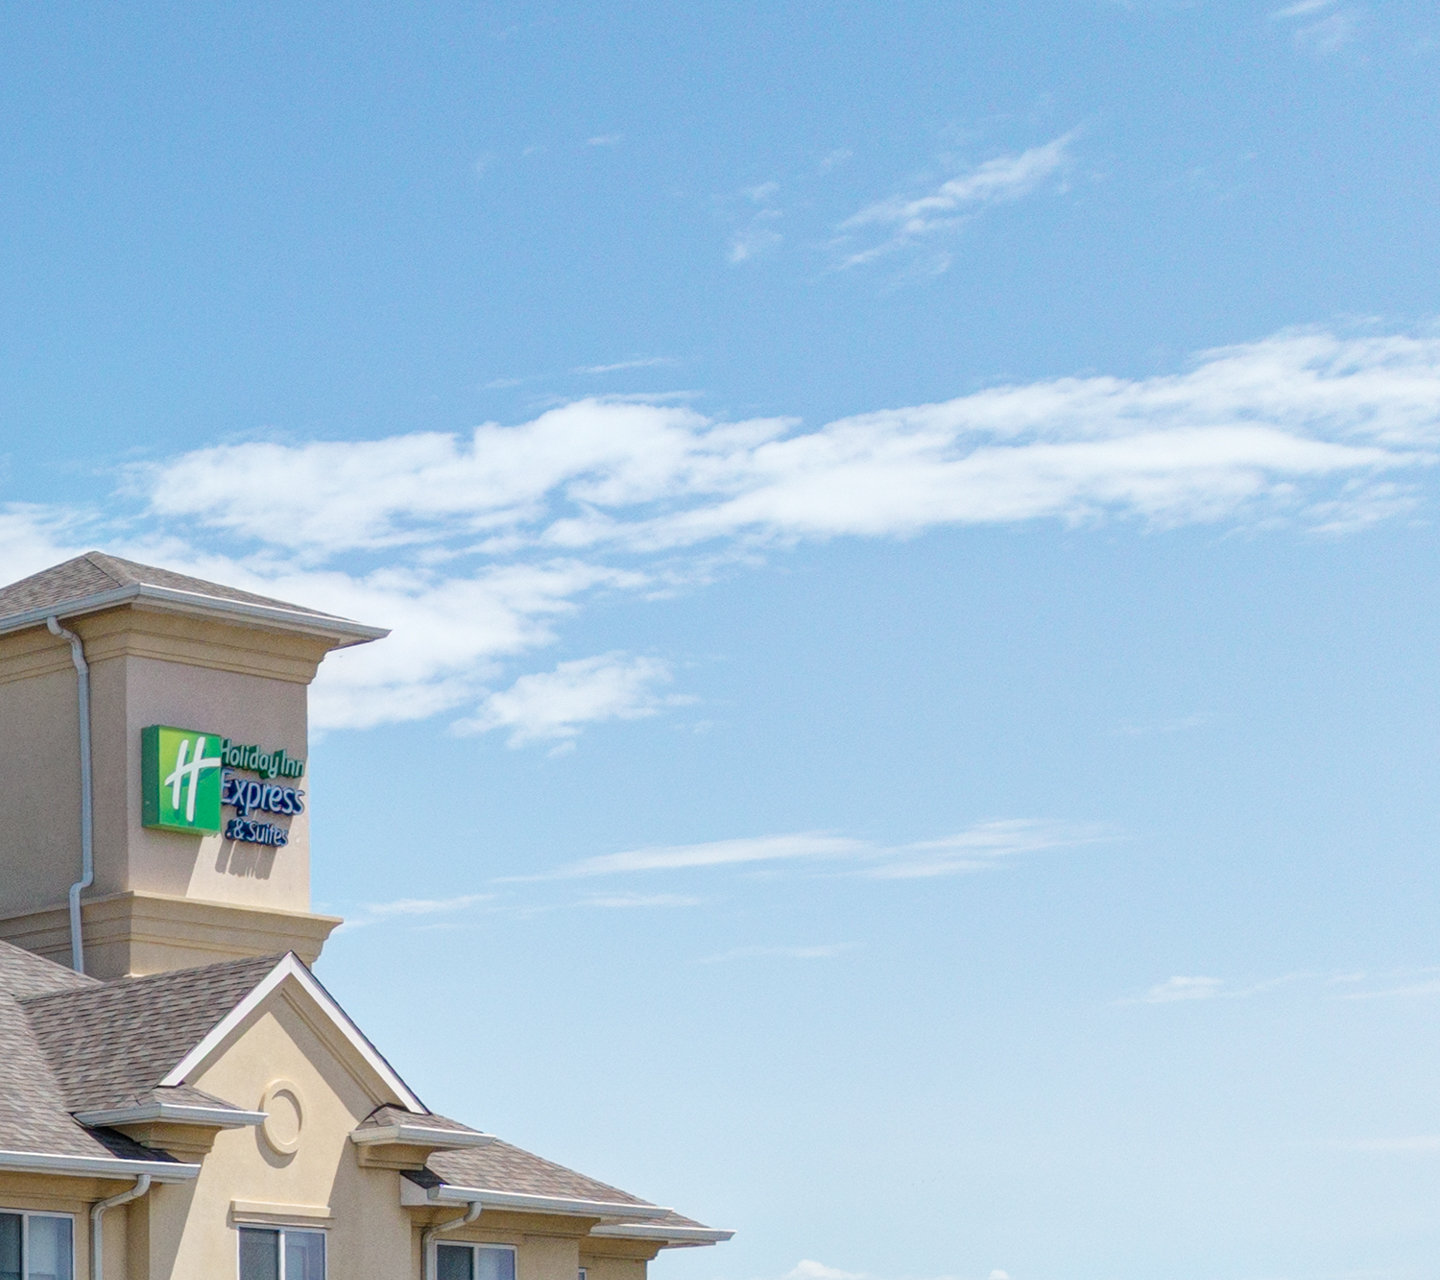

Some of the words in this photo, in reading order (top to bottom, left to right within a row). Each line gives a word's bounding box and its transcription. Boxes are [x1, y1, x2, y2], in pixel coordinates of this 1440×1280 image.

[221, 738, 280, 780] Holiday
[280, 748, 304, 777] Inn
[220, 768, 305, 816] Express
[231, 818, 245, 840] &
[246, 820, 288, 847] Suites
